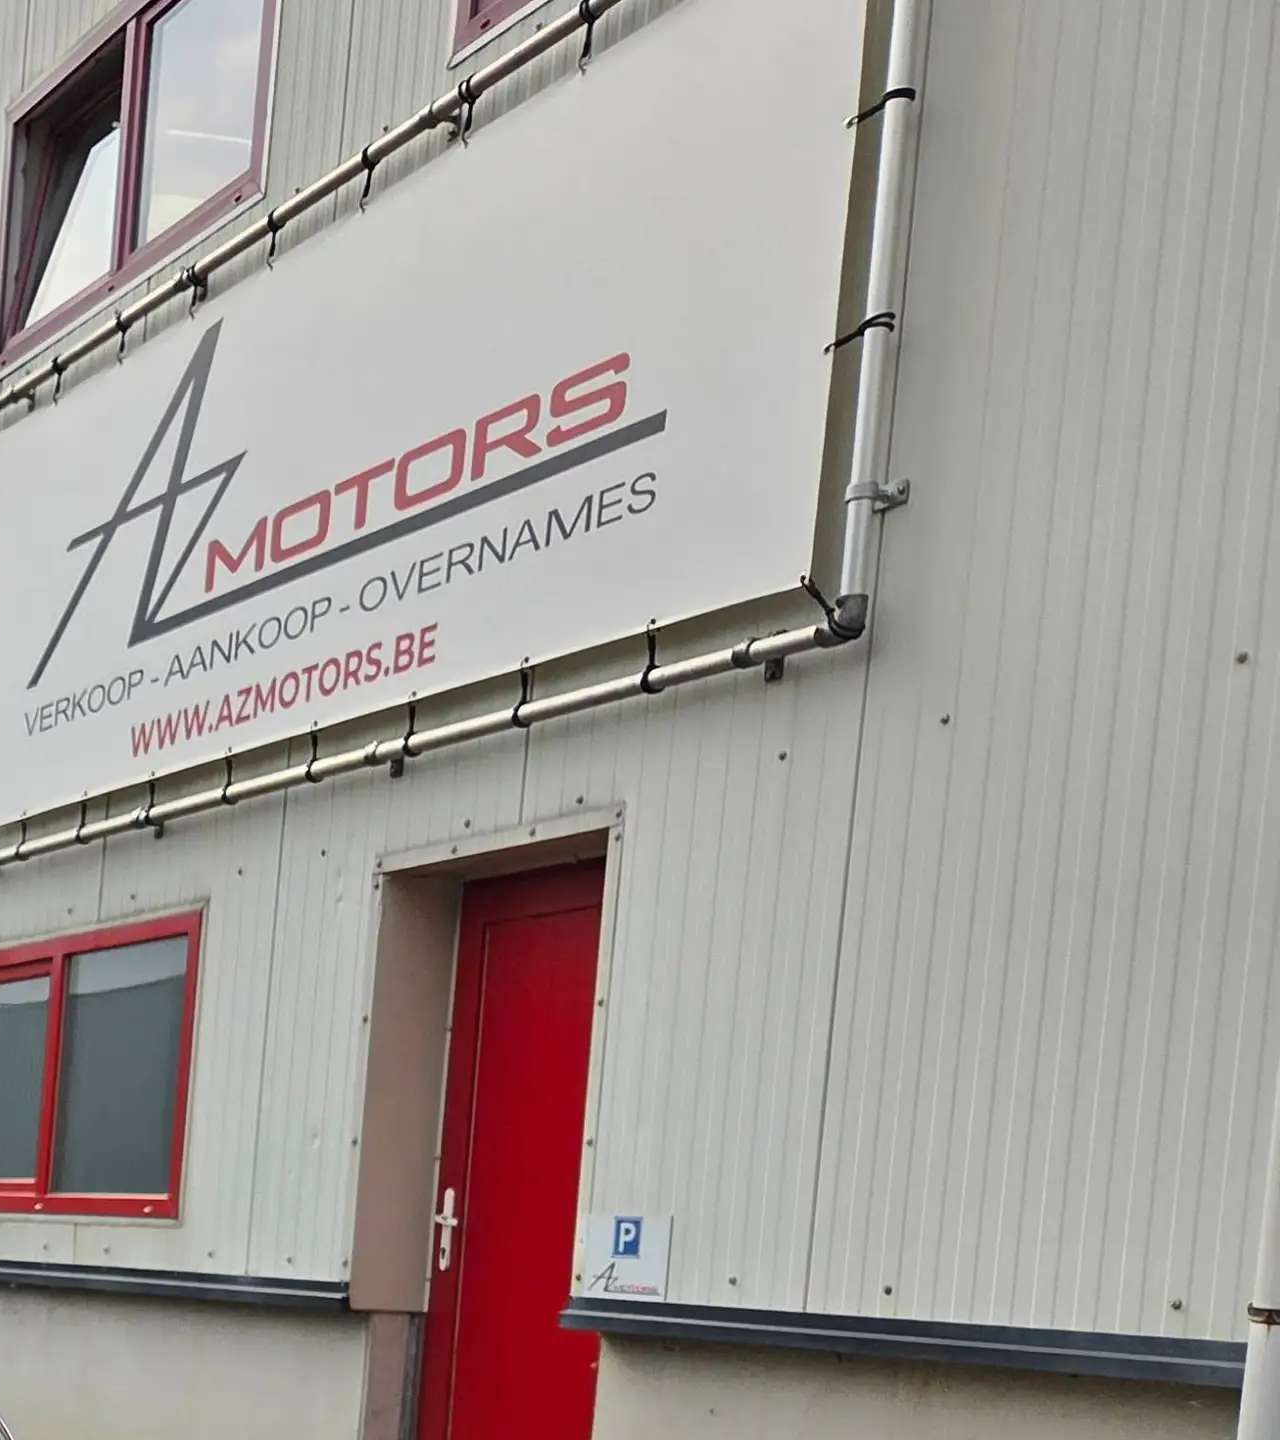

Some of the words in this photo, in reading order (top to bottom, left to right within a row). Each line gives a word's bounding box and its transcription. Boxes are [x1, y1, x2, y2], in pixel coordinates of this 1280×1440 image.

[203, 351, 632, 594] MOTORS
[23, 669, 145, 737] VERKOOP
[163, 596, 332, 688] AANKOOP
[359, 472, 657, 612] OVERNAMES
[130, 623, 438, 758] WWW.AZMOTORS.BE
[618, 1222, 637, 1253] P
